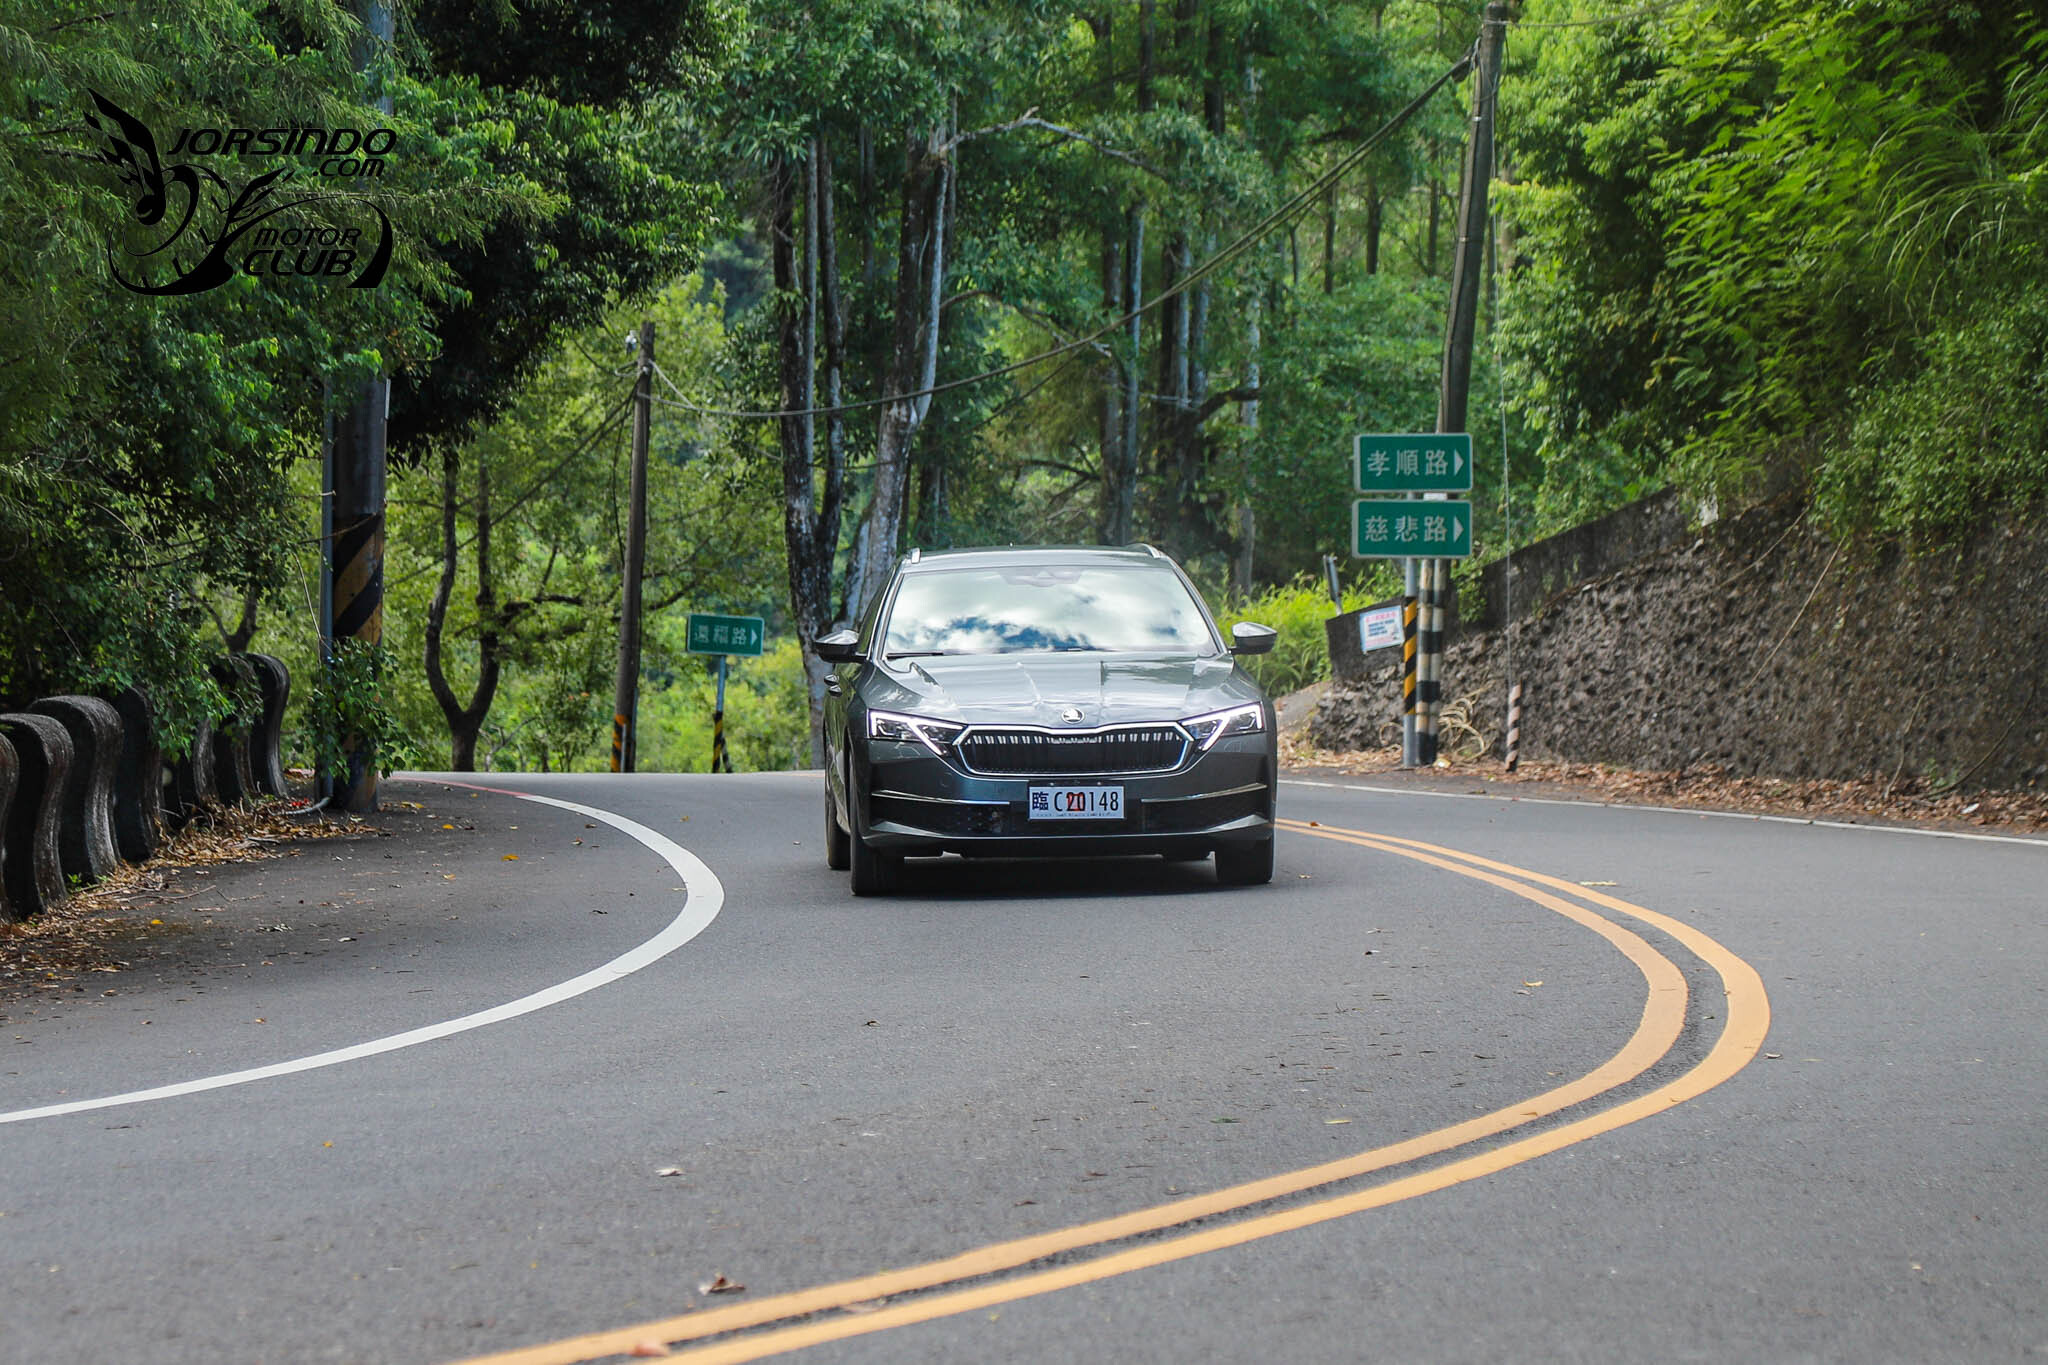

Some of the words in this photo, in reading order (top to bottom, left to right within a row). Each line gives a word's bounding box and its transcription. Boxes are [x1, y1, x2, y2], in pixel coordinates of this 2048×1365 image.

[1367, 449, 1449, 477] 孝順路
[1364, 515, 1448, 543] 慈悲路
[1032, 791, 1049, 811] 臨
[1054, 791, 1119, 812] C20148
